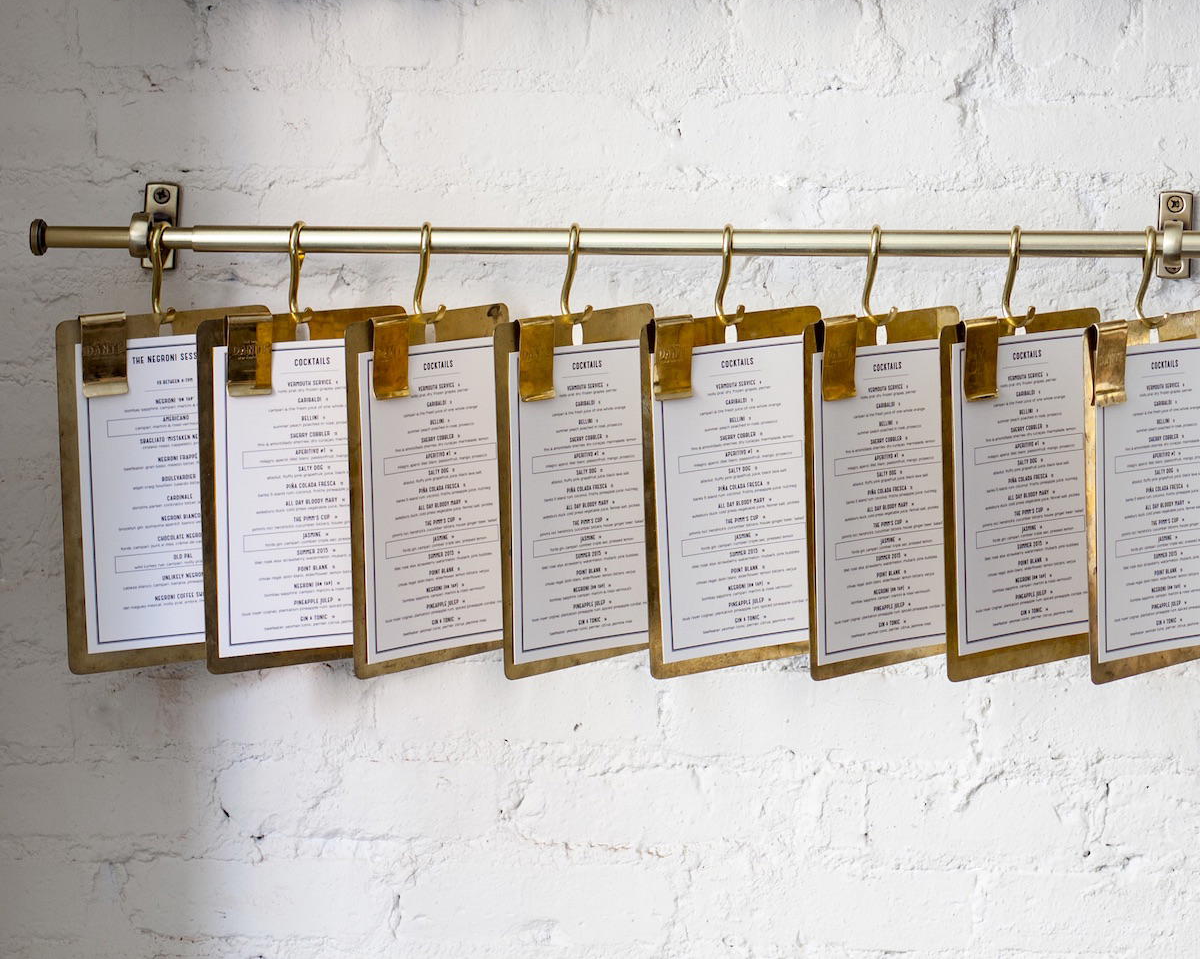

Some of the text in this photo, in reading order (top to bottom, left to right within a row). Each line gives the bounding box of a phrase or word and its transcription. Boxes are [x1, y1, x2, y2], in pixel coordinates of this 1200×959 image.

[1013, 350, 1042, 360] COCKTAILS
[294, 357, 330, 366] COCKTAILS
[424, 360, 453, 370] COCKTAILS
[572, 360, 602, 370] COCKTAILS
[721, 358, 754, 368] COCKTAILS
[873, 362, 902, 371] COCKTAILS
[1151, 360, 1178, 369] COCKTAILS
